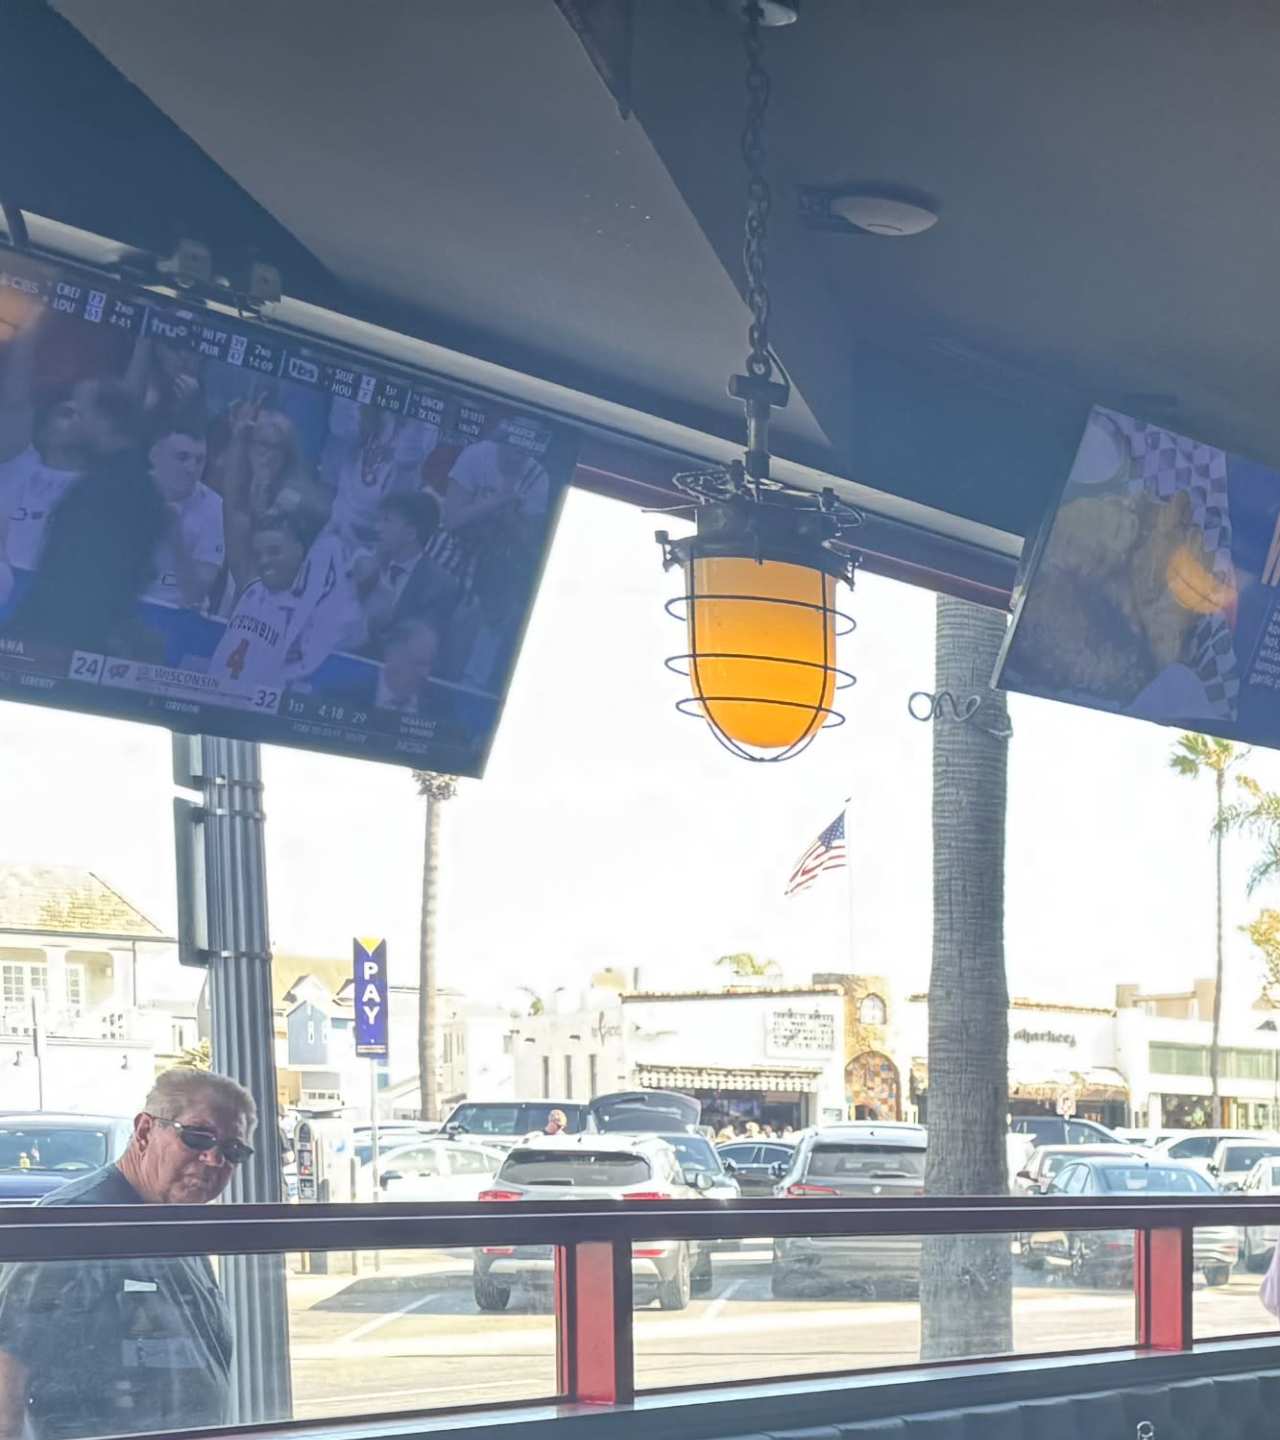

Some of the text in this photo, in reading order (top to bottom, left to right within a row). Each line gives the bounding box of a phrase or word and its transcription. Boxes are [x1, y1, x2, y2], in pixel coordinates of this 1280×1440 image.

[72, 655, 99, 678] 24
[153, 666, 220, 689] WISCONSIN
[253, 690, 279, 709] 32
[361, 960, 382, 1026] PAY
